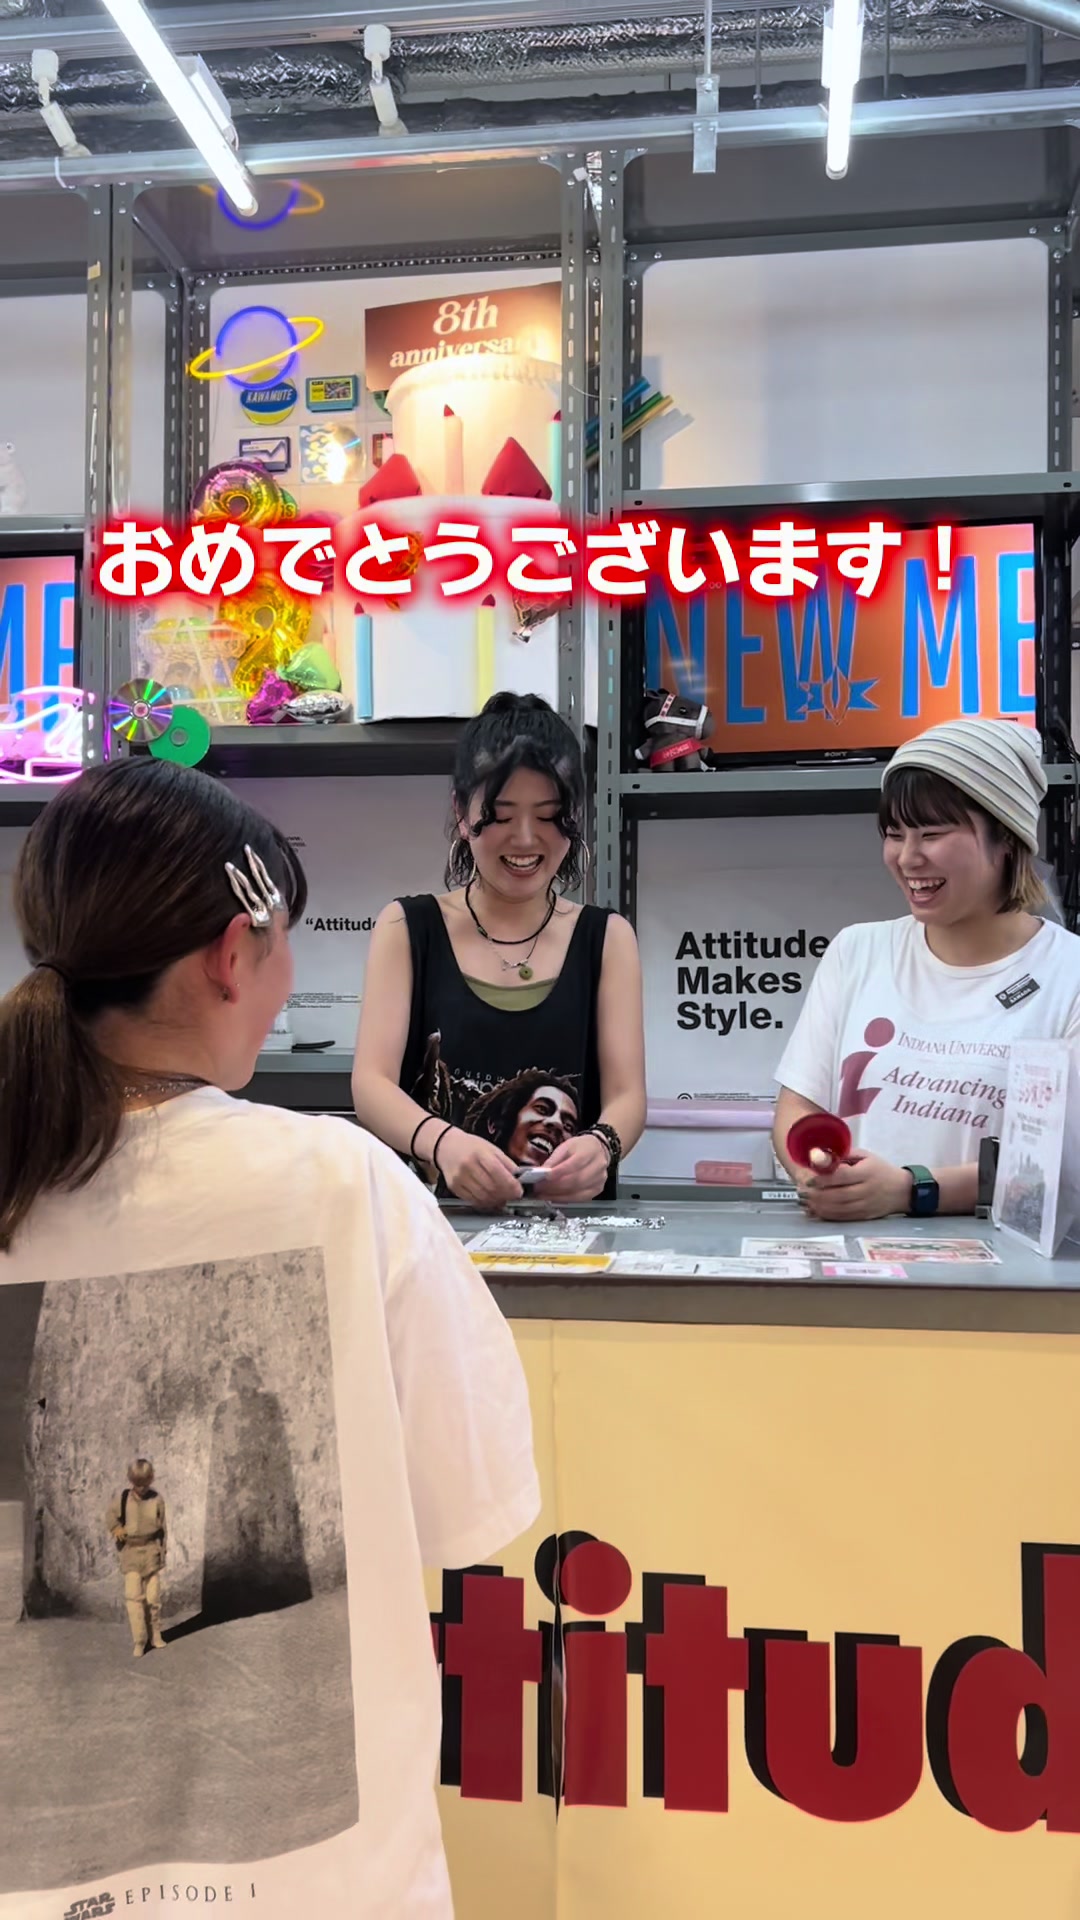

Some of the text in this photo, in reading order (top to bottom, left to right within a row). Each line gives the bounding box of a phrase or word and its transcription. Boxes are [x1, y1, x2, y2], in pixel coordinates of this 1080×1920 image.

[433, 296, 499, 335] 8th
[305, 917, 376, 931] “Attitud
[675, 929, 830, 960] Attitude
[677, 965, 803, 995] Makes
[676, 1001, 784, 1036] Style.
[882, 1066, 1007, 1110] Advancing
[891, 1094, 989, 1129] Indiana
[431, 1530, 1080, 1834] titud
[64, 1892, 116, 1916] STAR
[125, 1882, 256, 1905] EPISODE I
